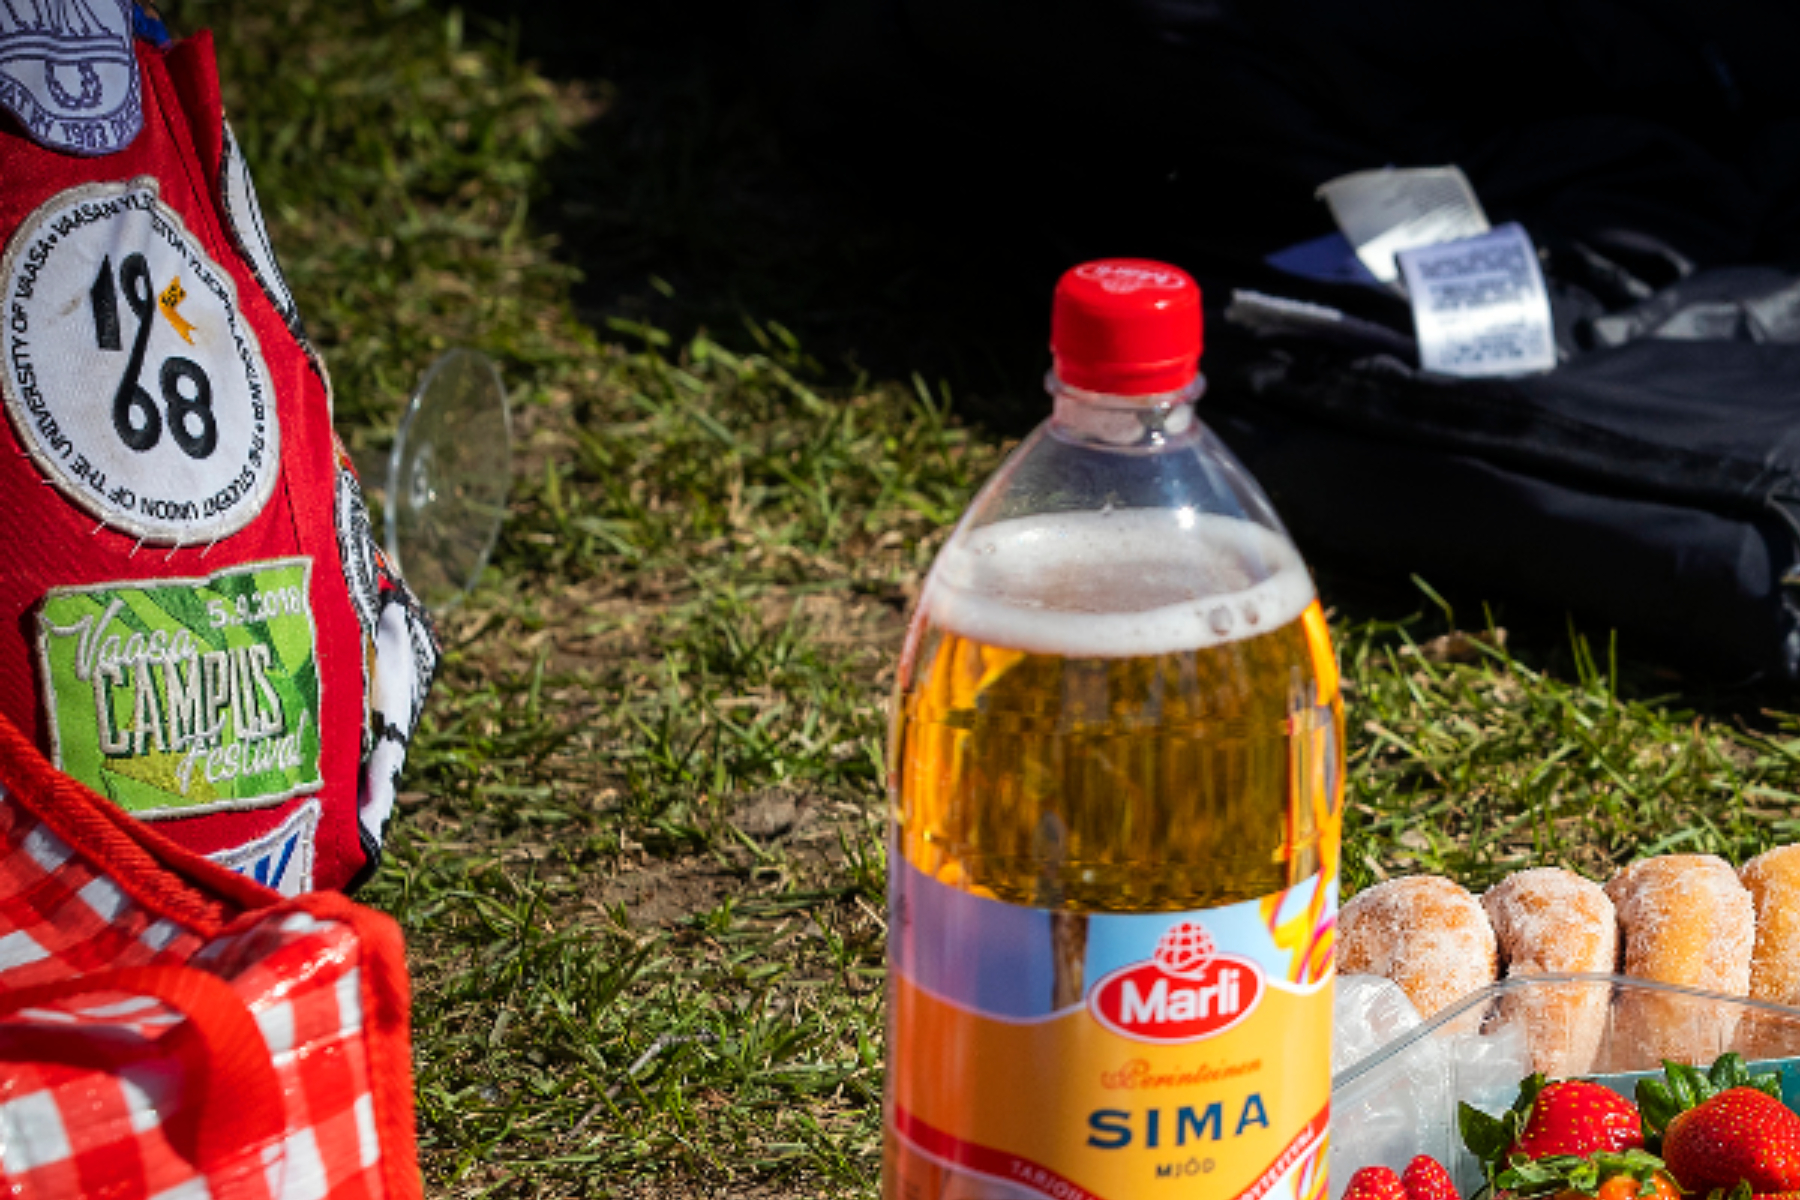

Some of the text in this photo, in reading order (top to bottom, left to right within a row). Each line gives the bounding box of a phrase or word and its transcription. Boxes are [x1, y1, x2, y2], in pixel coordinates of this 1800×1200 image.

[14, 239, 55, 299] VAASA
[11, 300, 29, 333] OF
[11, 335, 74, 460] UNIVERSITY
[69, 453, 106, 495] THE
[107, 486, 136, 510] OF
[40, 598, 198, 681] Vaasa
[93, 643, 287, 758] CAMPUS
[175, 707, 312, 796] Festival
[1120, 967, 1241, 1025] Marli
[1086, 1091, 1270, 1150] SIMA
